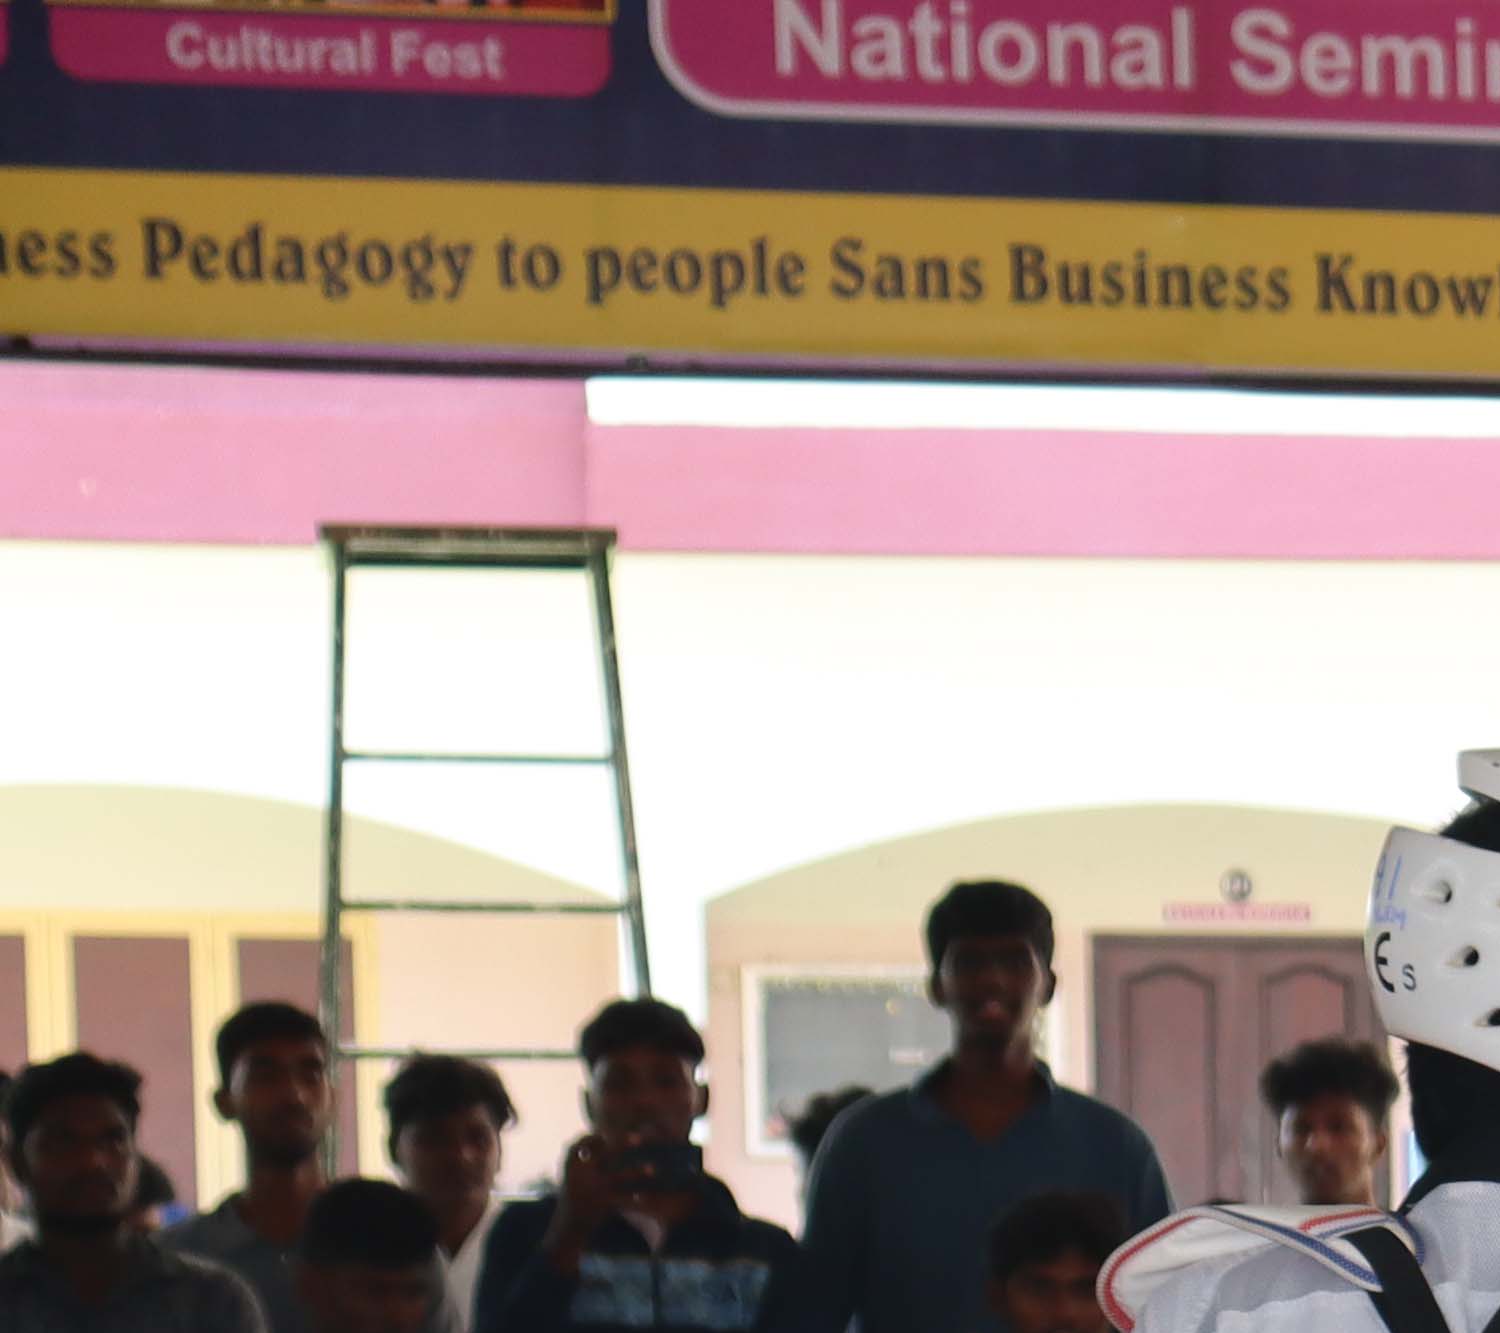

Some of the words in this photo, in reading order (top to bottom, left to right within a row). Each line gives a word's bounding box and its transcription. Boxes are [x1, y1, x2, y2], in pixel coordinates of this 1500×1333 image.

[166, 21, 377, 76] Cultural
[391, 32, 507, 82] Fest
[774, 0, 1195, 90] National
[0, 226, 117, 280] ess
[142, 217, 475, 300] Pedagogy
[497, 236, 562, 292] to
[584, 236, 806, 308] people
[829, 236, 984, 302] Sans
[1006, 243, 1292, 312] Business
